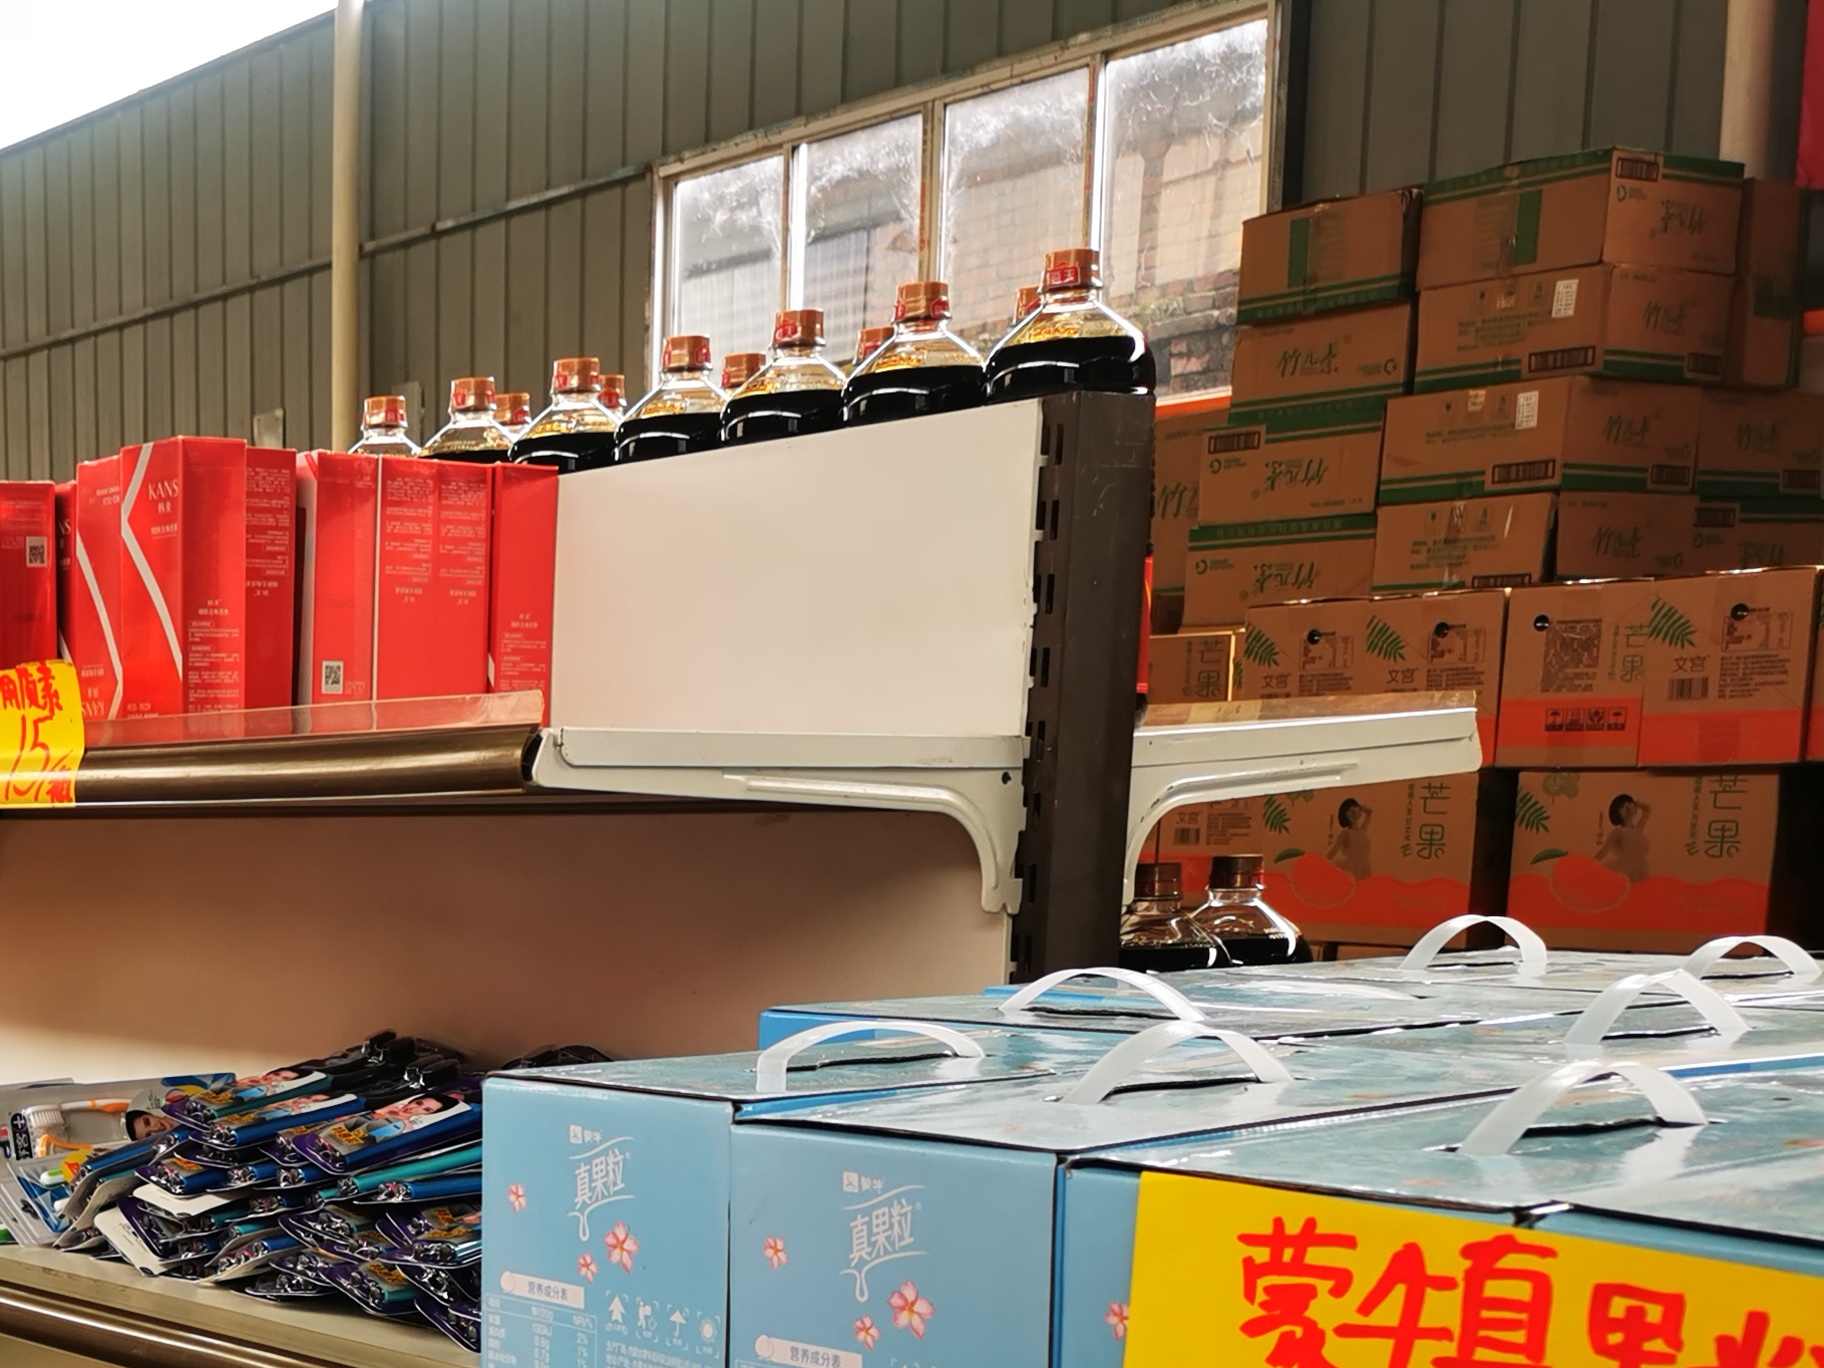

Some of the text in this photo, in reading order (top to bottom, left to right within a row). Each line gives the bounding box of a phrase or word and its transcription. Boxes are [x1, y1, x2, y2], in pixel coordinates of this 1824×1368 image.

[1415, 781, 1452, 861] 芒果
[1703, 773, 1748, 859] 芒果
[573, 1147, 626, 1211] 真果粒
[849, 1197, 914, 1268] 真果粒
[527, 1280, 569, 1302] 营养成分表
[789, 1345, 842, 1368] 营养成分表
